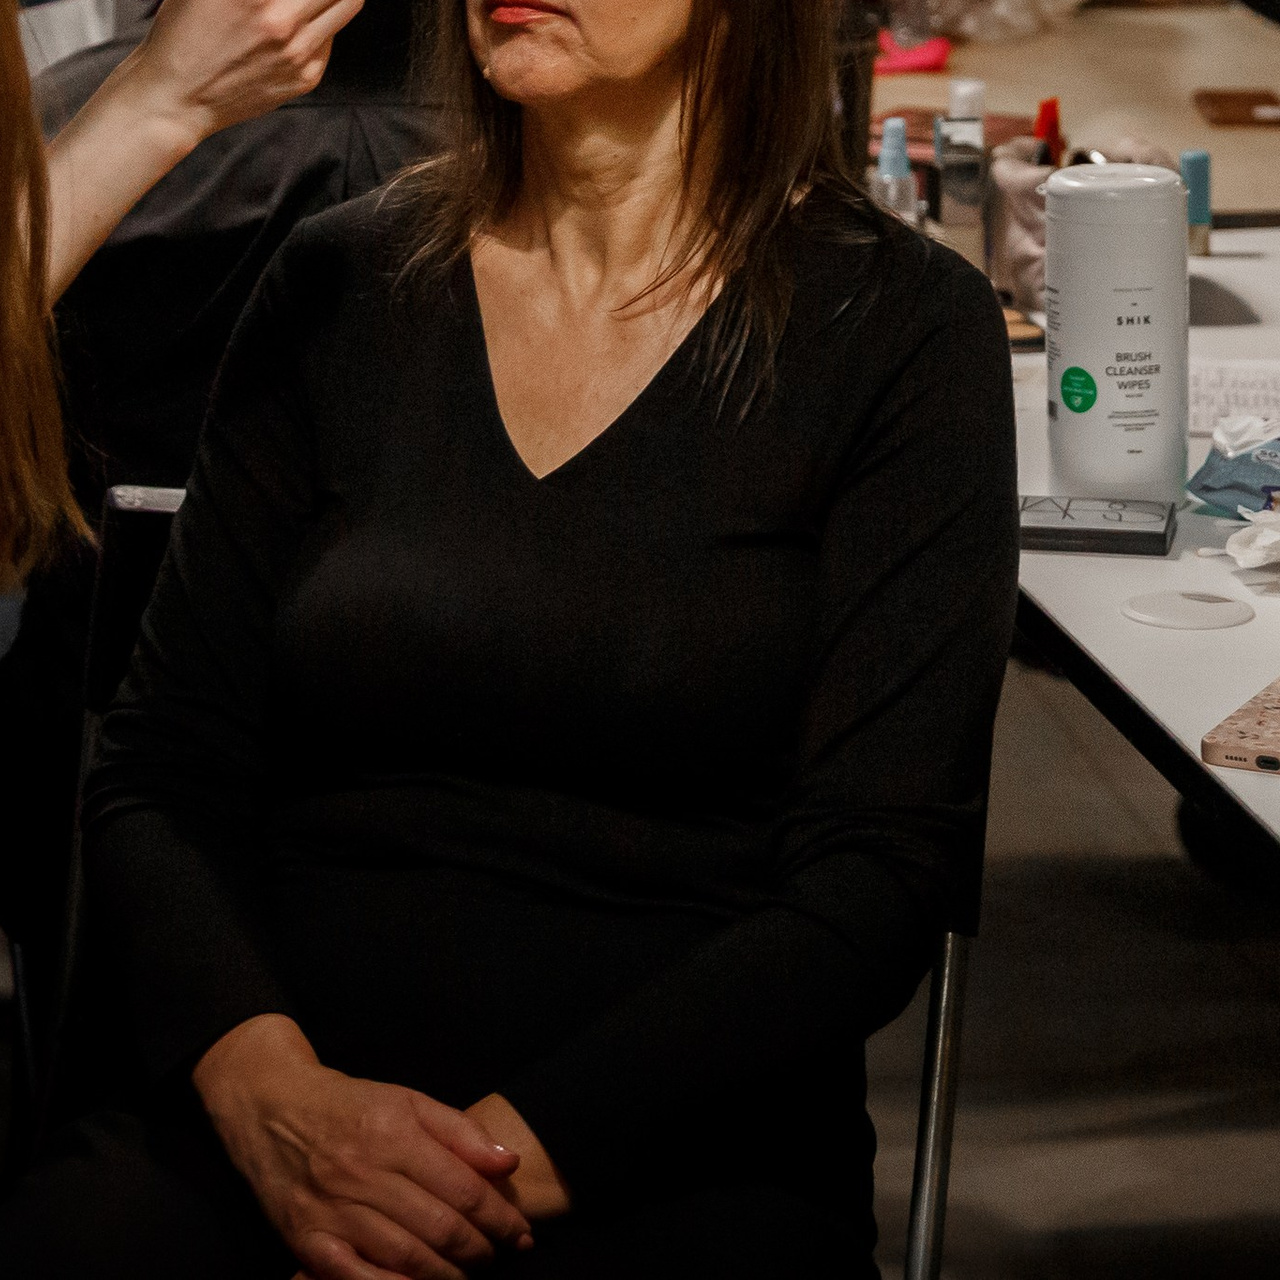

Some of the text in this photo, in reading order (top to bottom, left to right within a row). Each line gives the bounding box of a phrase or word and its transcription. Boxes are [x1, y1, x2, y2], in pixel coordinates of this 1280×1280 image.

[1116, 315, 1151, 326] SHIK
[1115, 351, 1152, 362] BRUSH
[1105, 363, 1161, 377] CLEANSER
[1116, 379, 1151, 390] WIPES
